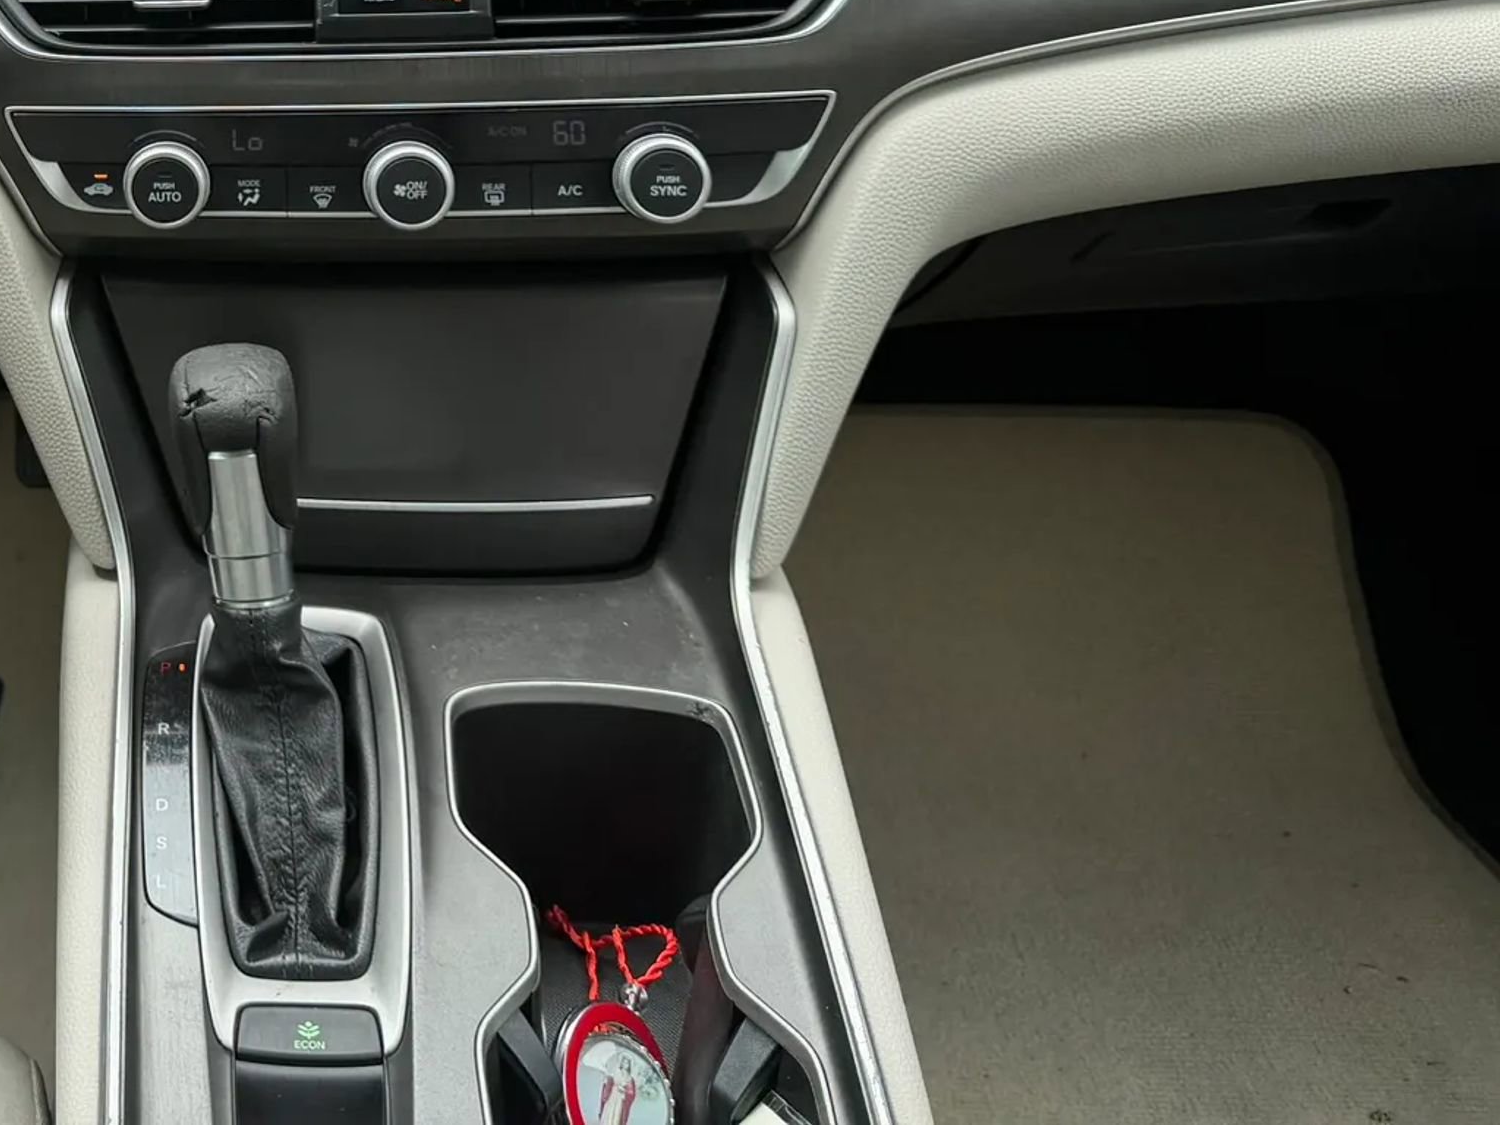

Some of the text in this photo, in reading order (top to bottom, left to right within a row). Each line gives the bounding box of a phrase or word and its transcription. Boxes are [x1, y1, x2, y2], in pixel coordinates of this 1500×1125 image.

[553, 120, 586, 146] 60
[237, 179, 261, 187] MODE
[656, 175, 680, 184] PUSH
[153, 182, 176, 190] PUSH
[309, 185, 336, 193] FRONT
[482, 182, 506, 191] REAR
[557, 185, 583, 196] A/C
[650, 185, 687, 196] SYNC
[148, 191, 182, 202] AUTO
[406, 190, 428, 200] OFF
[158, 723, 170, 735] R
[155, 798, 169, 812] D
[156, 836, 167, 850] S
[156, 875, 167, 889] L
[293, 1039, 325, 1050] ECON
